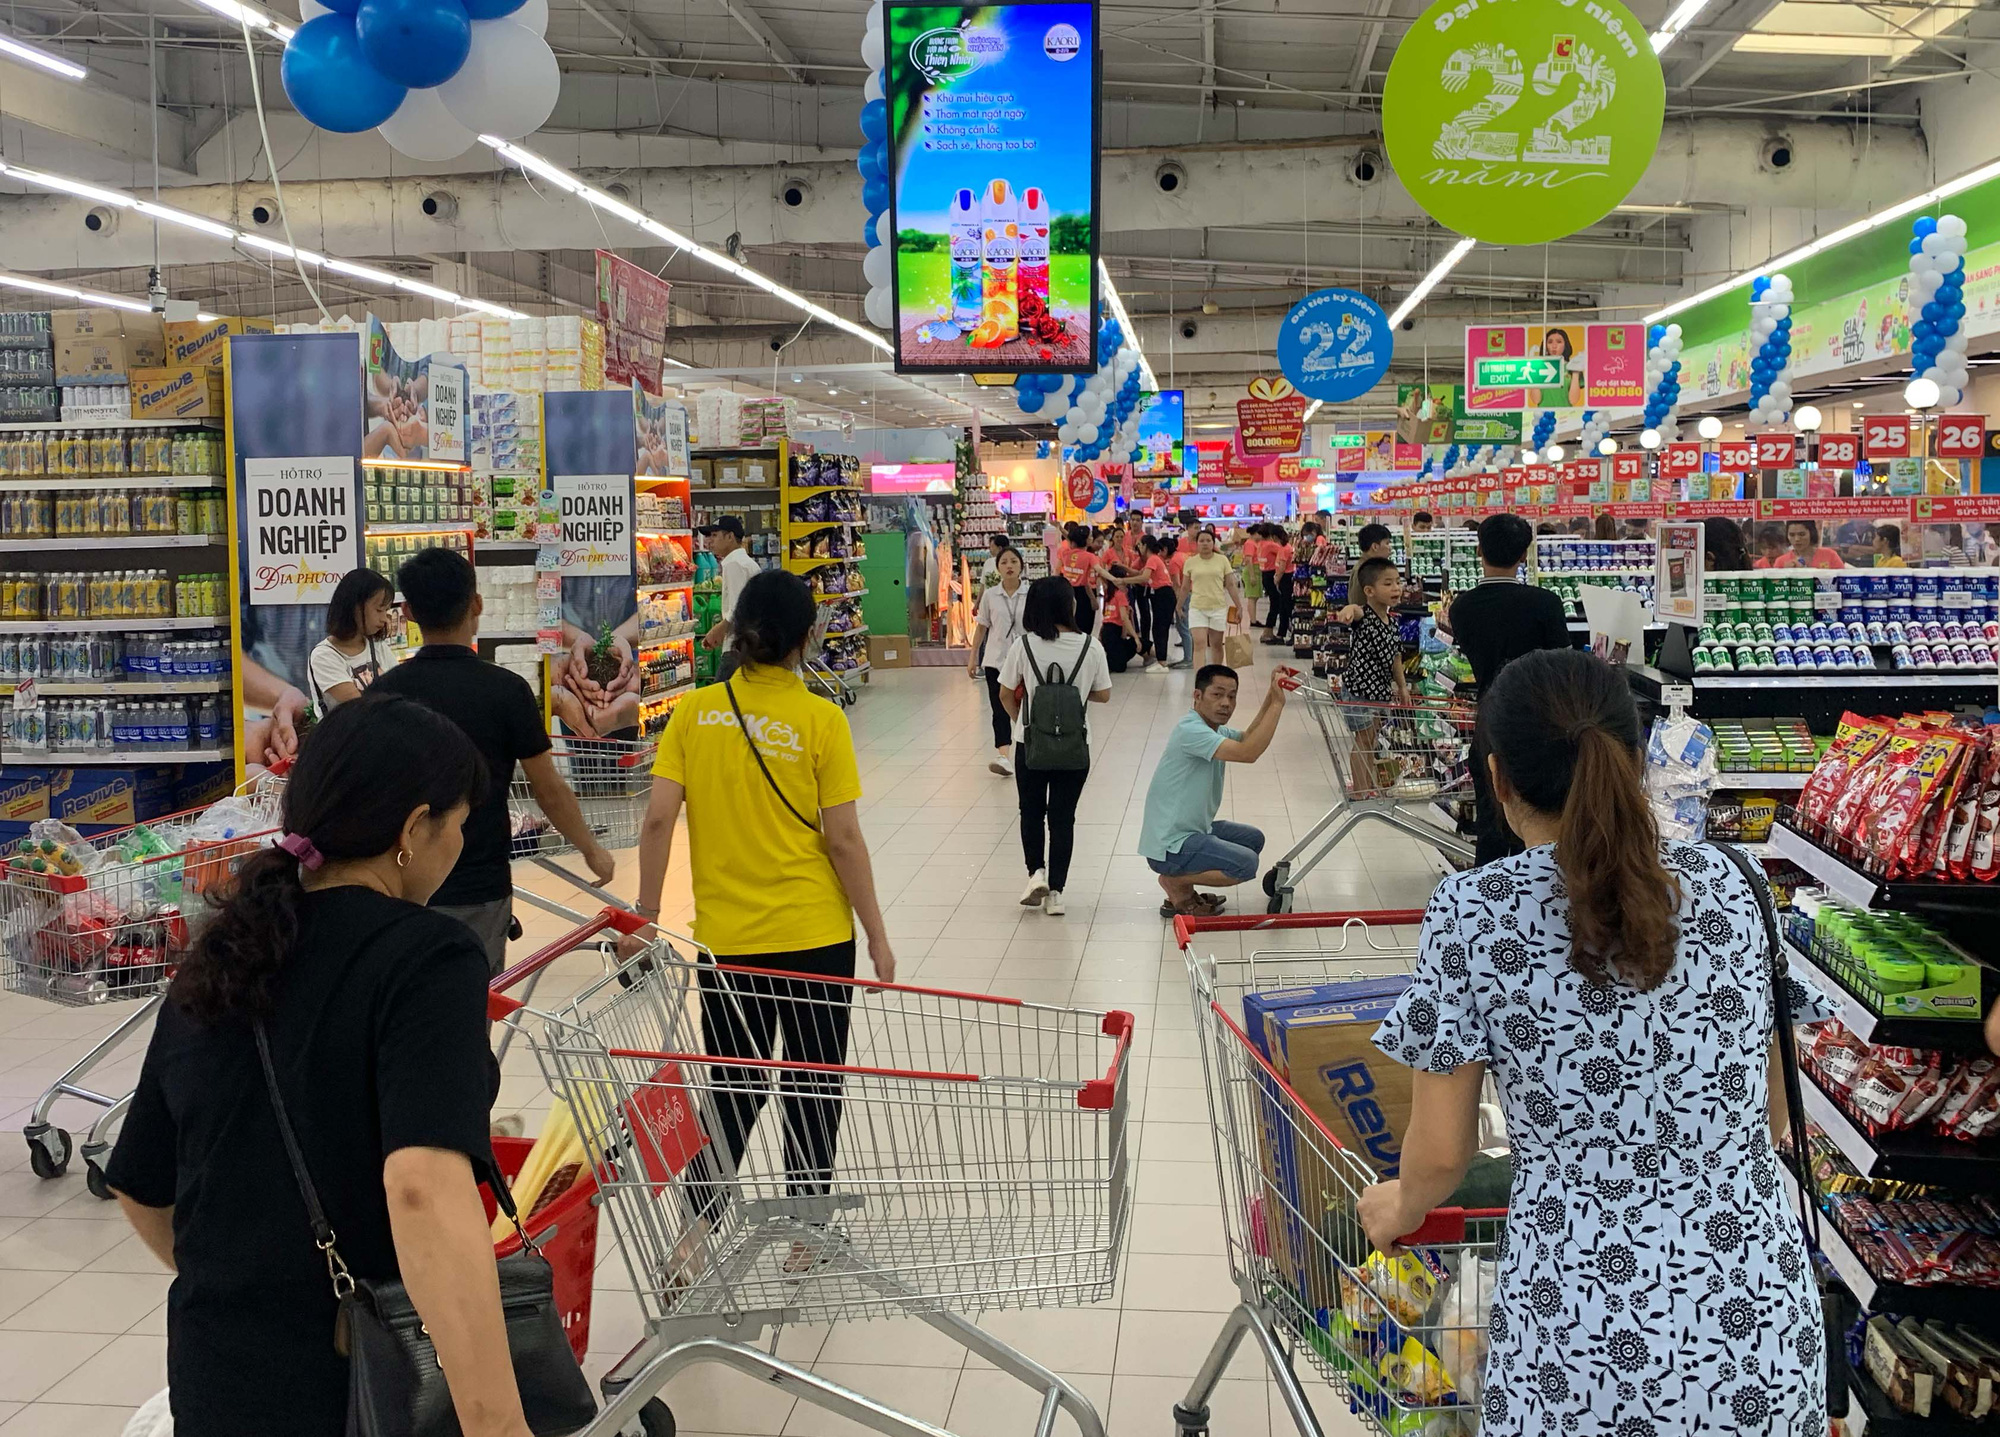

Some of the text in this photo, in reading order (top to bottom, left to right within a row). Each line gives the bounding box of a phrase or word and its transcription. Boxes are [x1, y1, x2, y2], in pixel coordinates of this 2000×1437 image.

[1047, 36, 1078, 46] KAORI
[1431, 43, 1617, 165] 22
[1420, 163, 1610, 189] năm
[954, 248, 979, 256] KAORI
[986, 248, 1015, 256] KAORI
[1021, 248, 1046, 256] KAORI
[1299, 320, 1375, 373] 22
[1490, 375, 1511, 383] EXIT
[1596, 379, 1607, 388] Gọi
[140, 371, 193, 409] Revive
[435, 384, 457, 405] DOANH
[1589, 386, 1643, 397] 1900 1880
[435, 406, 457, 430] NGHIỆP
[1868, 426, 1906, 449] 25
[1942, 426, 1980, 449] 26
[1672, 448, 1697, 467] 29
[1722, 450, 1749, 466] 30
[1761, 443, 1792, 461] 27
[1822, 443, 1854, 461] 28
[1578, 464, 1598, 478] 33
[1618, 459, 1638, 475] 31
[1505, 473, 1521, 483] 37
[1528, 469, 1547, 481] 35
[1456, 481, 1469, 490] 41
[1479, 478, 1495, 488] 39
[258, 487, 345, 517] DOANH
[562, 496, 623, 517] DOANH
[1789, 499, 1807, 507] Kính
[1808, 499, 1825, 507] chắn
[1954, 498, 1976, 506] Kính
[1792, 507, 1809, 515] sức
[1957, 507, 1978, 515] sức
[260, 519, 347, 559] NGHIỆP
[562, 518, 624, 546] NGHIỆP
[297, 572, 345, 584] PHƯƠN
[1838, 725, 1850, 736] 12
[1894, 738, 1908, 748] 12
[62, 778, 128, 818] Revive
